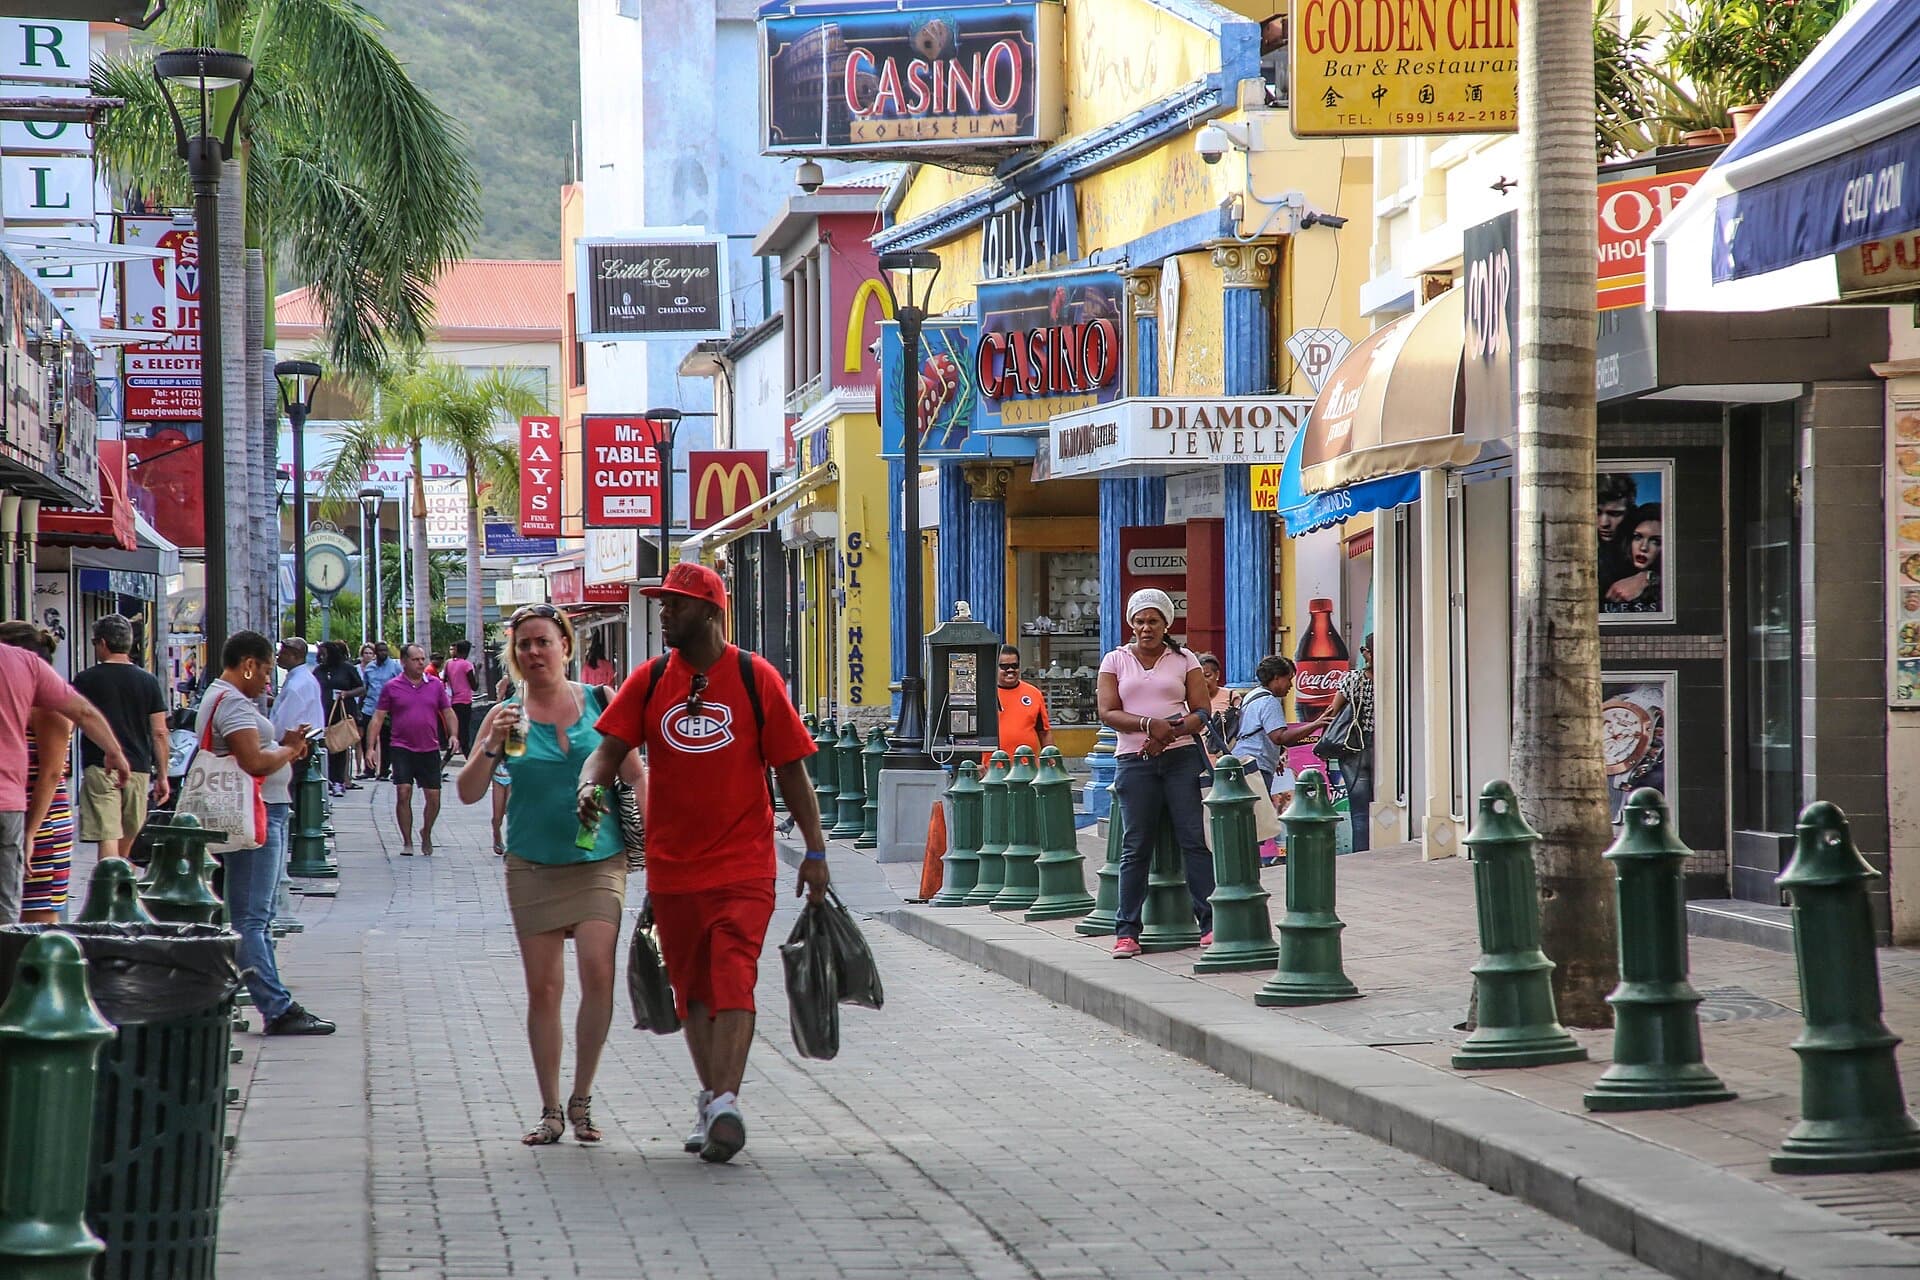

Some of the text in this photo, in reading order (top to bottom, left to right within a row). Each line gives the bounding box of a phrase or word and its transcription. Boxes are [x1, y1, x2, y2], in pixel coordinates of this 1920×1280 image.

[1305, 0, 1436, 54] GOLDEN
[1324, 59, 1366, 77] Bar
[1372, 58, 1388, 76] &
[845, 39, 1023, 116] CASINO
[1337, 113, 1373, 125] TEL:
[598, 257, 711, 288] Little Europe
[609, 305, 706, 316] DAMIANI CHIMENTO
[132, 359, 144, 369] &
[976, 318, 1118, 399] CASINO
[154, 390, 168, 398] Tel:
[1150, 406, 1312, 429] DIAMON
[615, 425, 643, 442] Mr.
[1169, 430, 1298, 455] JEWELE
[595, 446, 657, 463] TABLE
[1221, 454, 1250, 462] FRONT
[527, 422, 553, 510] RAY'S
[594, 470, 659, 488] CLOTH
[522, 522, 555, 530] JEWELRY
[1134, 556, 1187, 568] CITIZEN
